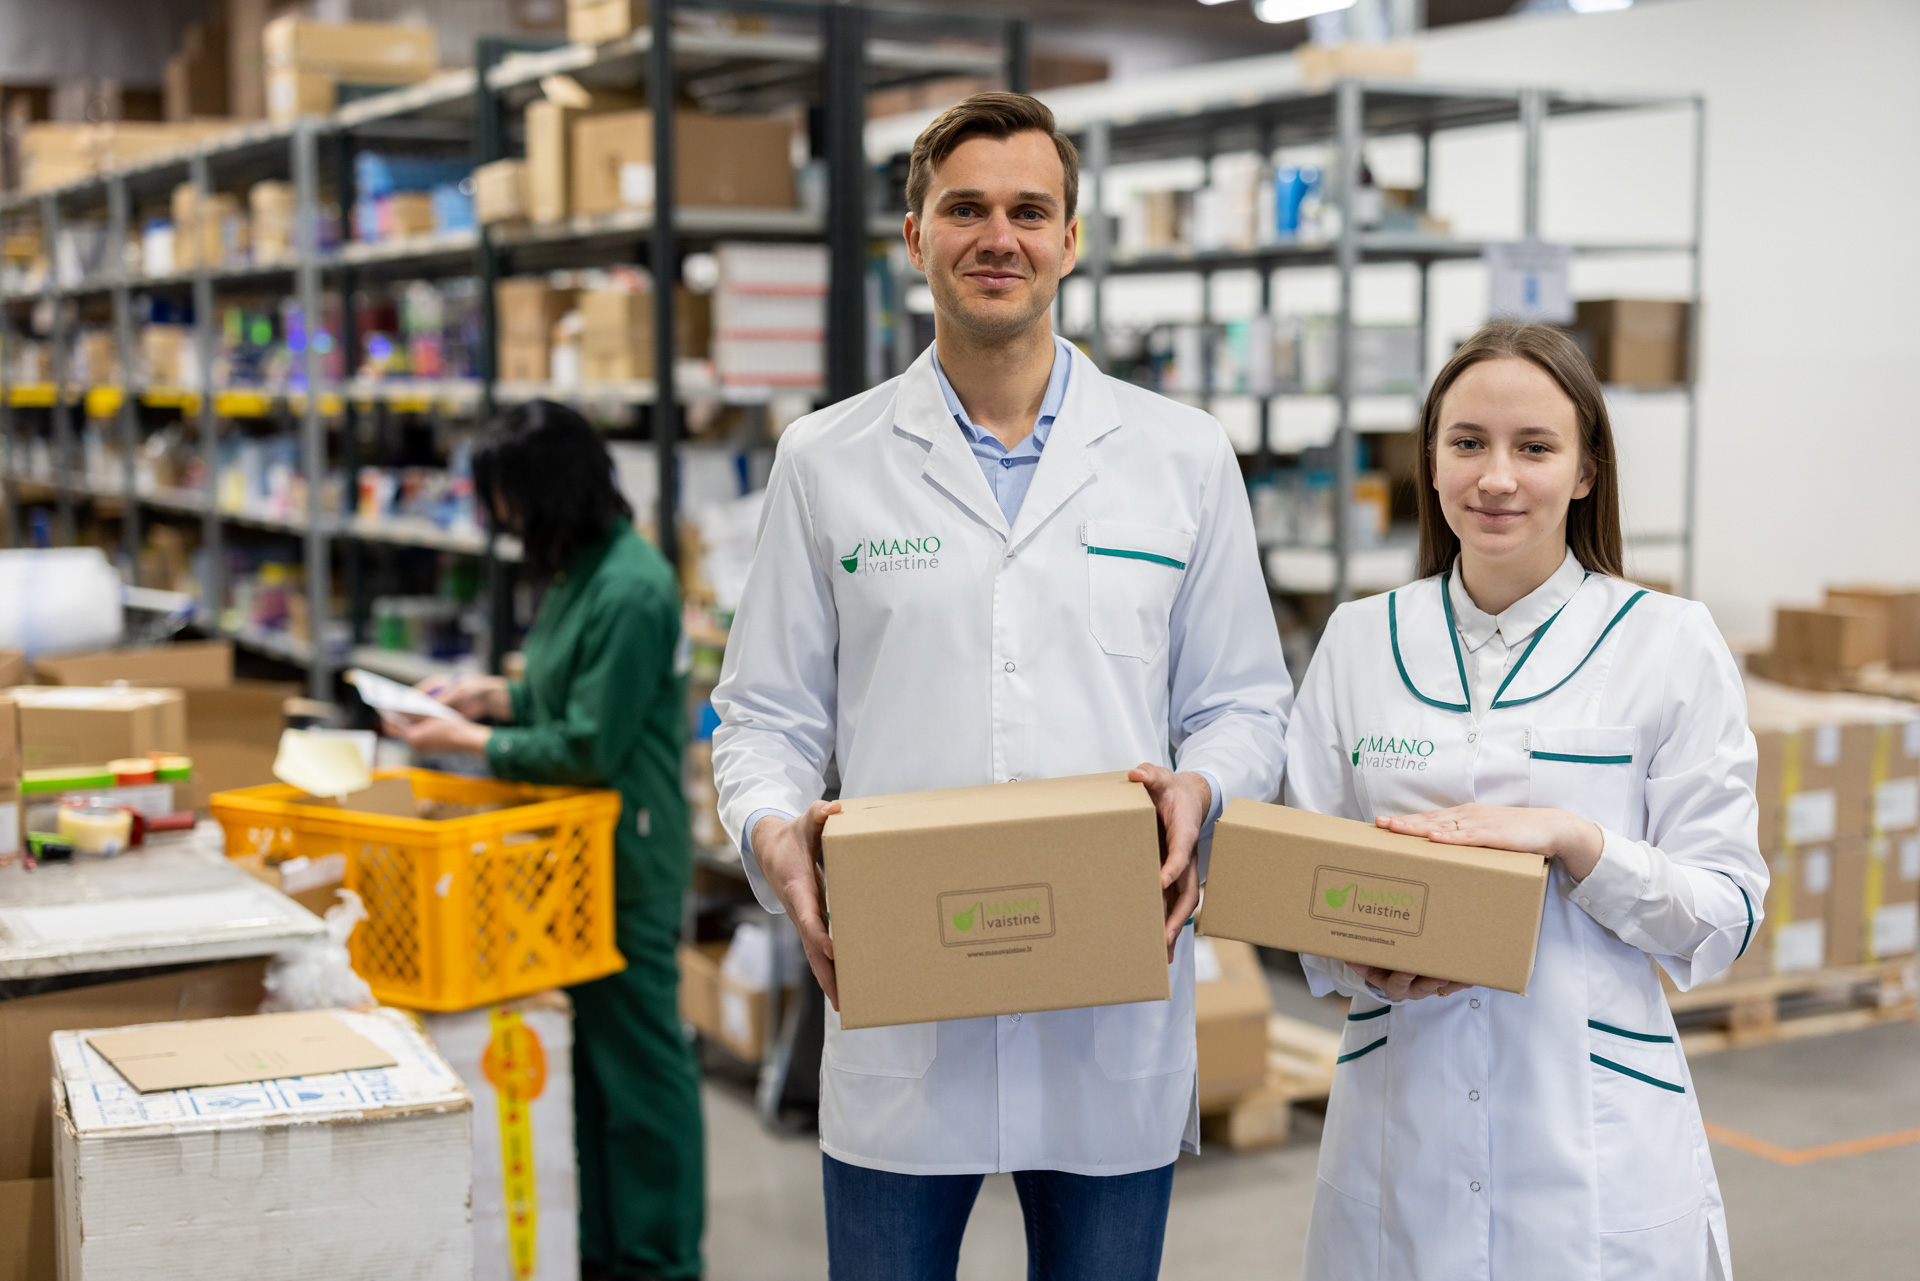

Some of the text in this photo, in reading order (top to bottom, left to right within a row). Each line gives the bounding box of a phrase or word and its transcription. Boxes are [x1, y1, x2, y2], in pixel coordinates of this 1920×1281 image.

[868, 536, 941, 558] MANO
[869, 553, 940, 573] vaistinė
[1366, 735, 1434, 757] MANO
[1365, 753, 1428, 771] vaistinė
[985, 897, 1041, 916] MANO
[1359, 887, 1415, 909] MANO
[986, 911, 1041, 928] vaistinė
[1357, 903, 1411, 921] vaistinė
